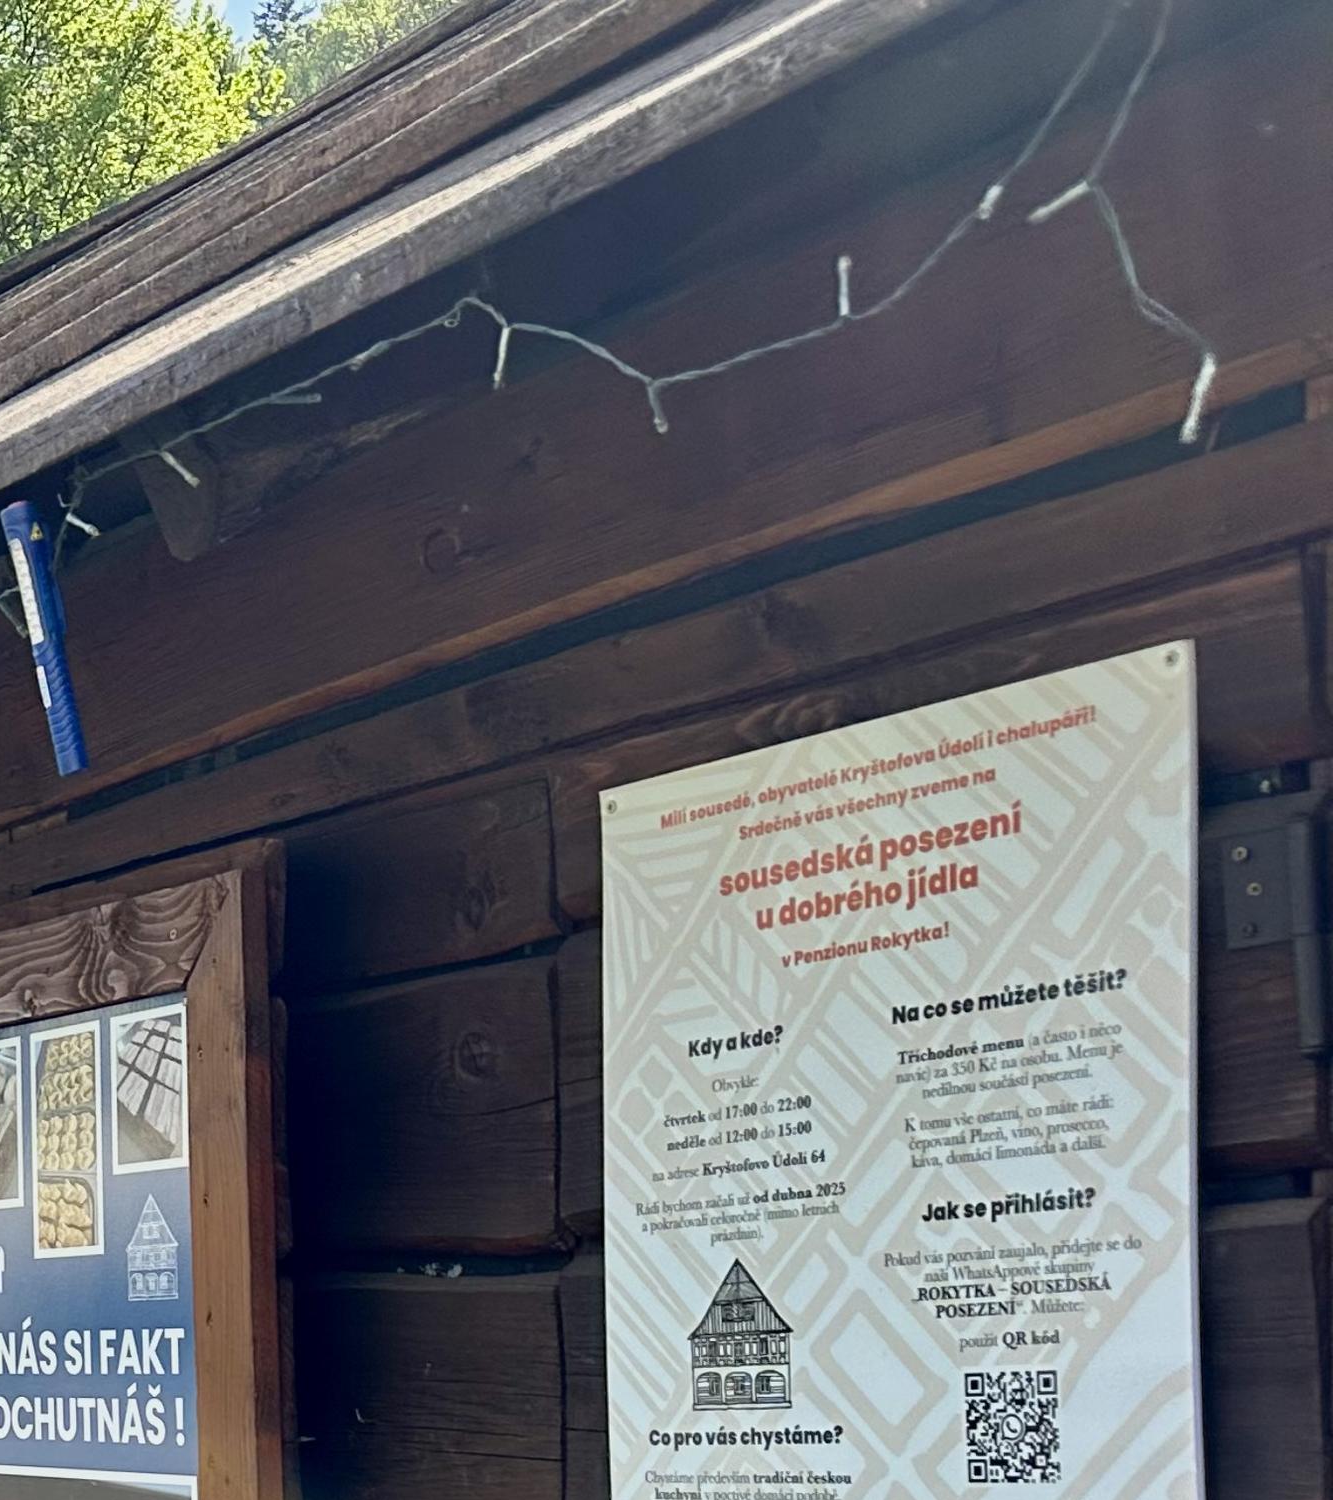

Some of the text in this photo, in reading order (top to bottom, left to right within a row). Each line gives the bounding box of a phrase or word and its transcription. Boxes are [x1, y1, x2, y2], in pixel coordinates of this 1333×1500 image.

[659, 805, 687, 830] Milí
[688, 789, 756, 823] sousedé,
[756, 767, 839, 805] obyvatelé
[839, 747, 936, 785] Kryštofova
[937, 730, 984, 760] Údolí
[985, 727, 994, 749] i
[737, 767, 996, 841] Srdečně vás všechny zveme na
[718, 798, 1022, 897] sousedská posezení
[755, 861, 979, 931] u dobrého jídla
[780, 919, 950, 968] v Penzionu Rokytka!
[890, 967, 1127, 1025] Na co se můžete těšit?
[687, 1023, 784, 1061] Kdy a kde?
[895, 1037, 1025, 1066] Tříchodové menu
[661, 1108, 707, 1128] čtvrtek
[724, 1100, 758, 1120] 17:00
[758, 1100, 775, 1115] do
[775, 1093, 812, 1113] 22:00
[665, 1133, 707, 1152] neděle
[724, 1126, 759, 1144] 12:00
[759, 1125, 776, 1140] do
[777, 1118, 813, 1138] 15:00
[701, 1156, 770, 1179] Kryštofovo
[770, 1149, 808, 1169] Údolí
[809, 1147, 826, 1164] 64
[751, 1180, 847, 1205] od dubna 2025
[920, 1186, 1096, 1223] Jak se přihlásit?
[882, 1249, 922, 1268] Pokud
[922, 1249, 944, 1265] vás
[944, 1244, 996, 1266] pozvání
[1121, 1233, 1143, 1250] do
[1009, 1270, 1112, 1296] SOUSEDSKÁ
[64, 1329, 92, 1376] SI
[99, 1328, 185, 1376] FAKT
[958, 1328, 1061, 1352] použít QR kód
[647, 1423, 844, 1452] Co pro vás chystáme?
[751, 1469, 853, 1485] tradiční českou
